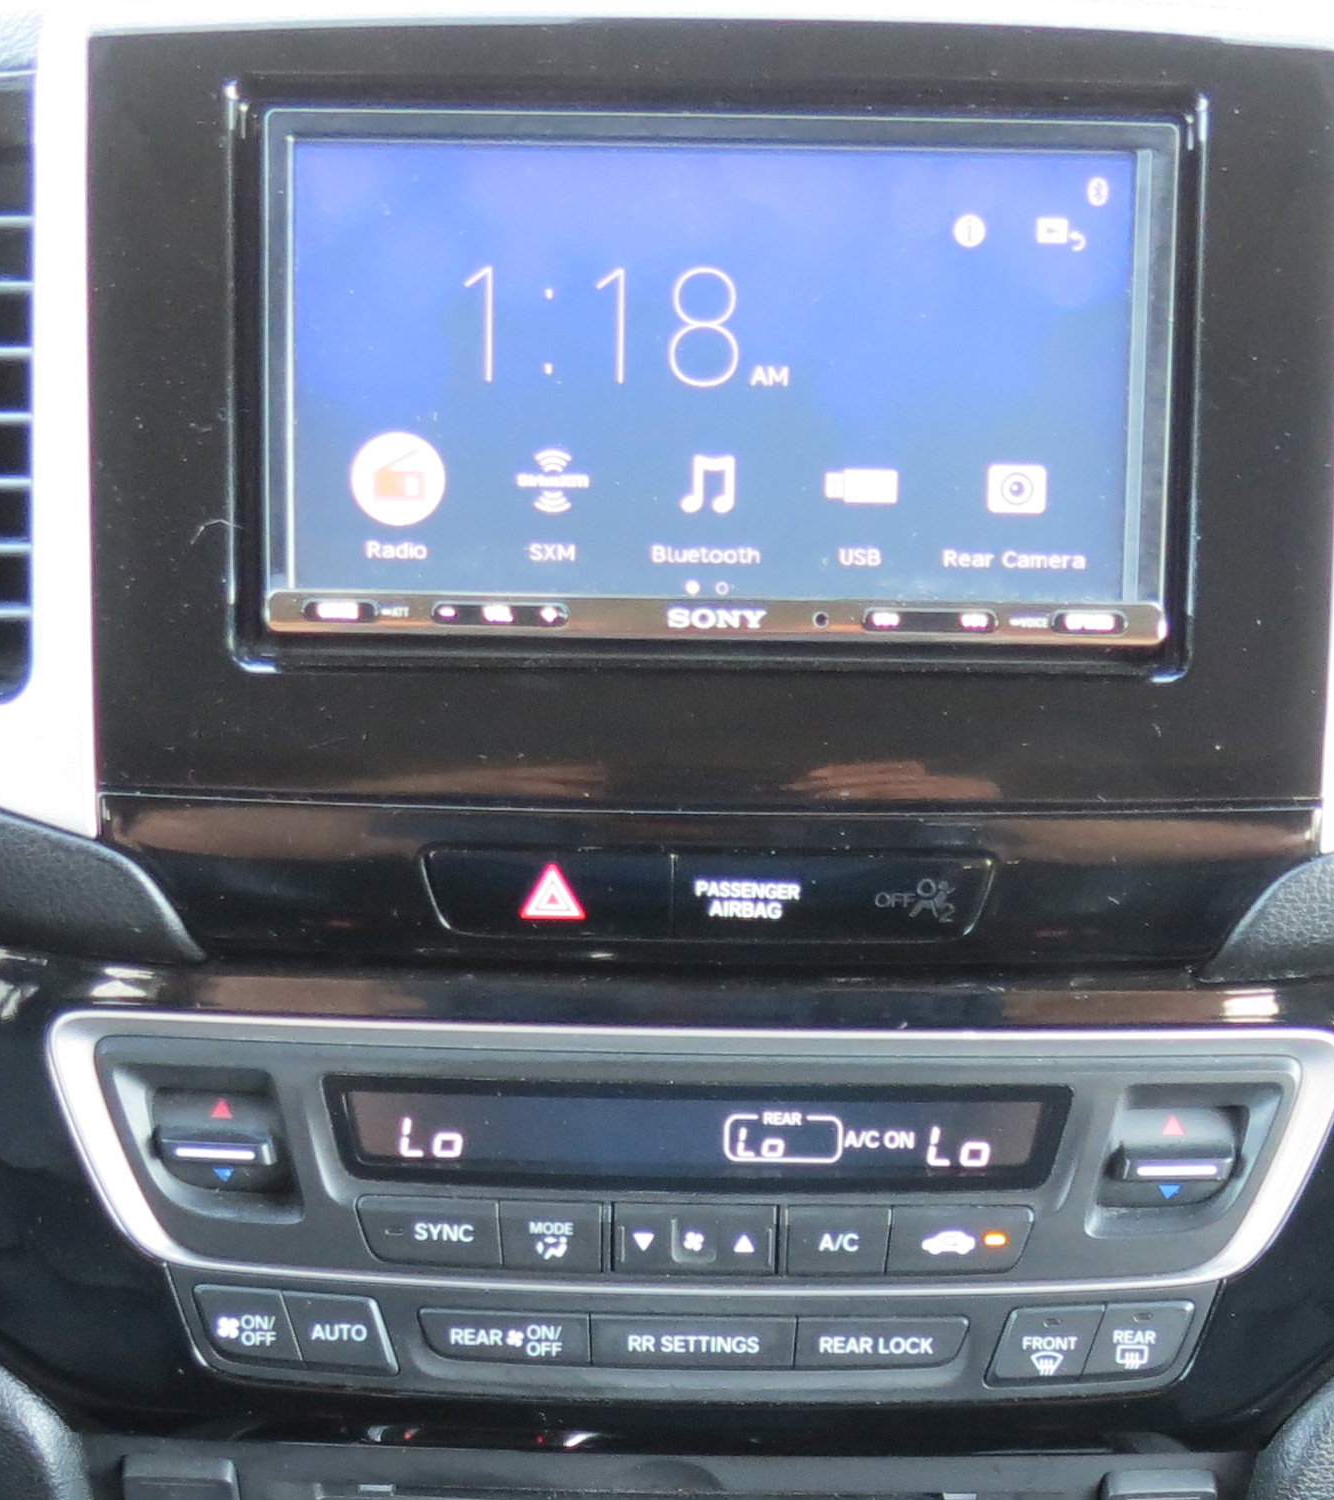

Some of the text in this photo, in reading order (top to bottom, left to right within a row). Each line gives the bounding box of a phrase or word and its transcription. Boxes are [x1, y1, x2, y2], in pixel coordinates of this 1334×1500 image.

[463, 265, 790, 387] 1:18 AM
[364, 539, 428, 560] Radio
[528, 542, 577, 562] SXM
[651, 544, 761, 566] Bluetooth
[839, 547, 882, 568] USB
[942, 549, 1086, 570] Rear Camera
[667, 607, 767, 630] SONY
[694, 879, 801, 901] PASSENGER
[874, 891, 912, 909] OFF
[708, 900, 784, 920] AIRBAG
[763, 1111, 802, 1126] REAR
[844, 1130, 880, 1150] A/C
[883, 1130, 916, 1149] ON
[413, 1222, 474, 1244] SYNC
[528, 1221, 574, 1237] MODE
[818, 1232, 860, 1253] A/C
[240, 1315, 276, 1331] ON/
[310, 1322, 368, 1343] AUTO
[241, 1330, 277, 1347] OFF
[449, 1325, 563, 1348] REAR ON/
[627, 1335, 760, 1355] RR SETTINGS
[819, 1336, 934, 1356] REAR LOCK
[1022, 1335, 1078, 1352] FRONT
[1112, 1329, 1156, 1347] REAR
[526, 1340, 563, 1358] OFF
